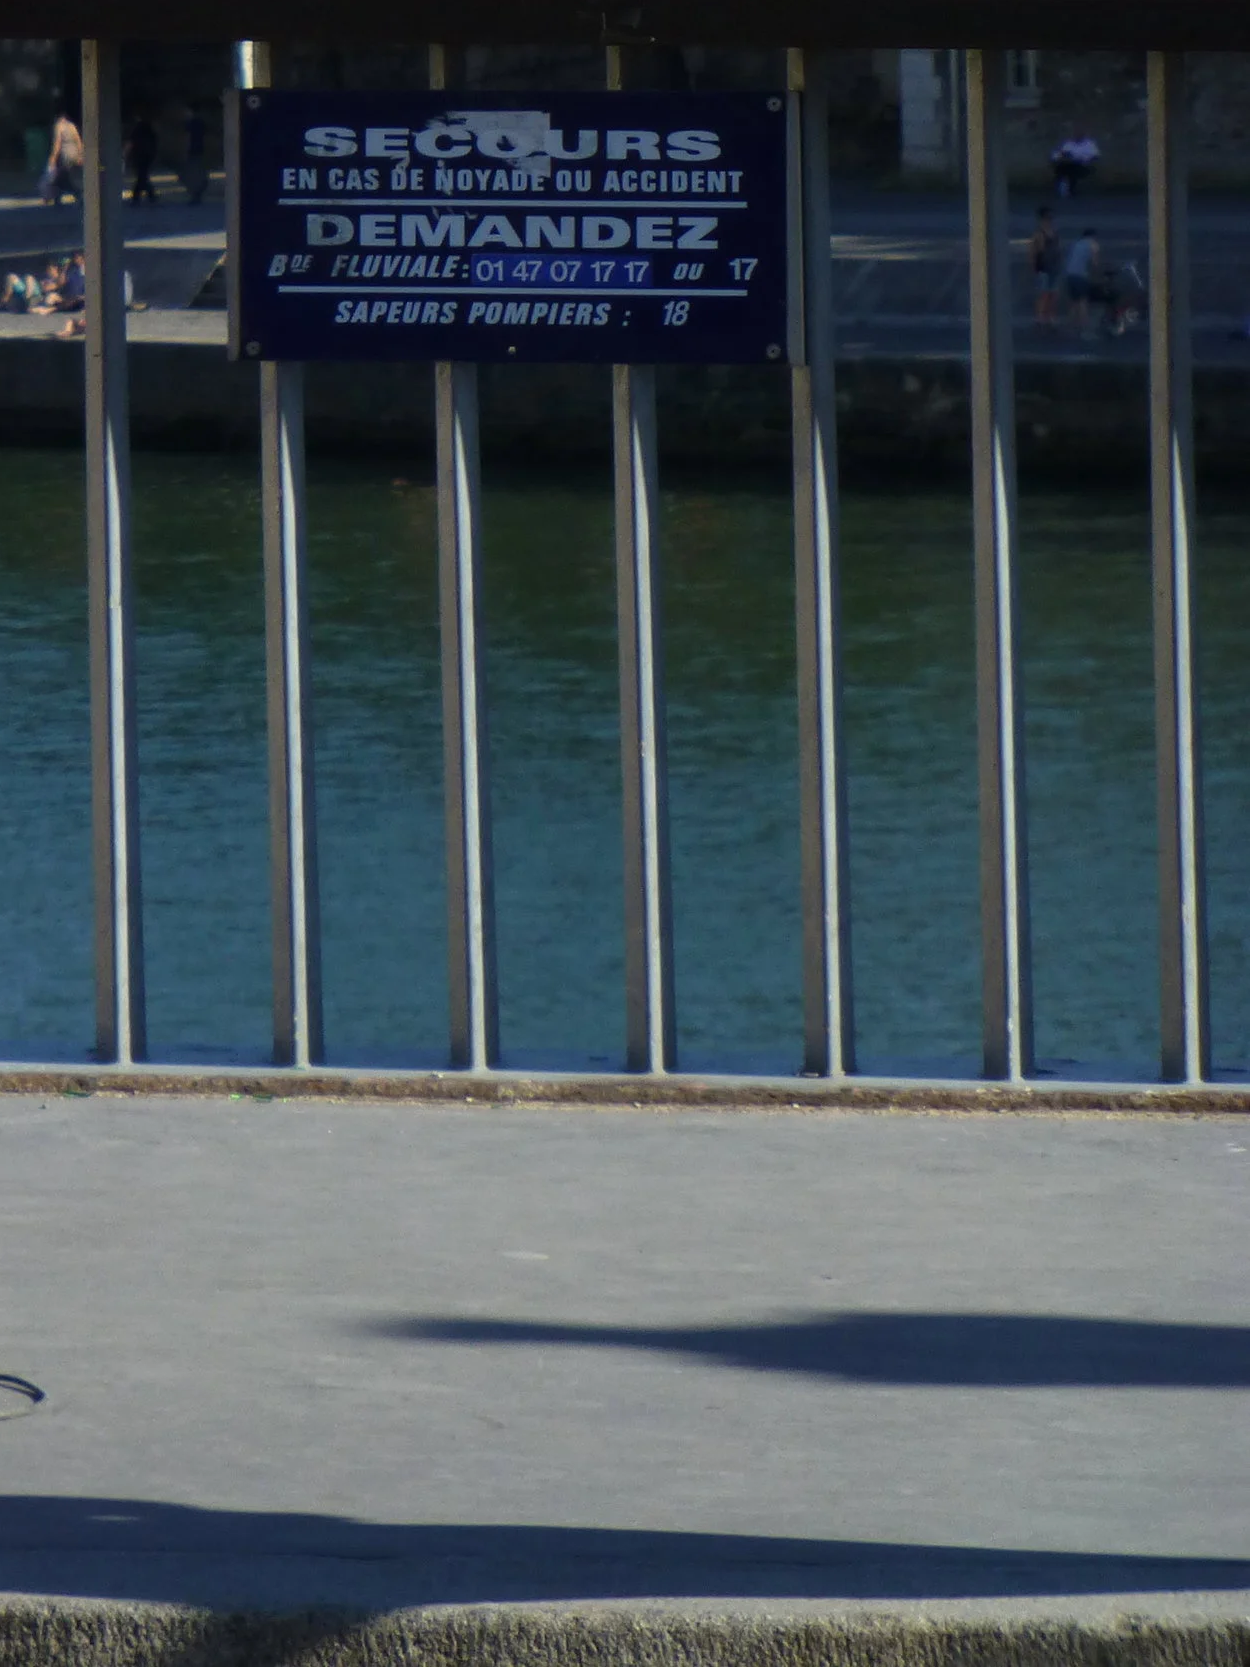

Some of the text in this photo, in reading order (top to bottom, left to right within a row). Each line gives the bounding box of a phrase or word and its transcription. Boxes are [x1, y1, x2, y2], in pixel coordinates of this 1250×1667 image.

[304, 127, 721, 161] SECOURS
[282, 168, 744, 193] EN CAS DE NOYADE OU ACCIDENT
[306, 214, 718, 249] DEMANDEZ
[475, 260, 504, 282] 01
[512, 260, 543, 282] 47
[550, 260, 582, 282] 07
[590, 261, 616, 282] 17
[623, 261, 650, 282] 17
[729, 258, 758, 281] 17
[335, 300, 458, 324] SAPEURS
[468, 301, 611, 326] POMPIERS
[663, 300, 690, 326] 18
